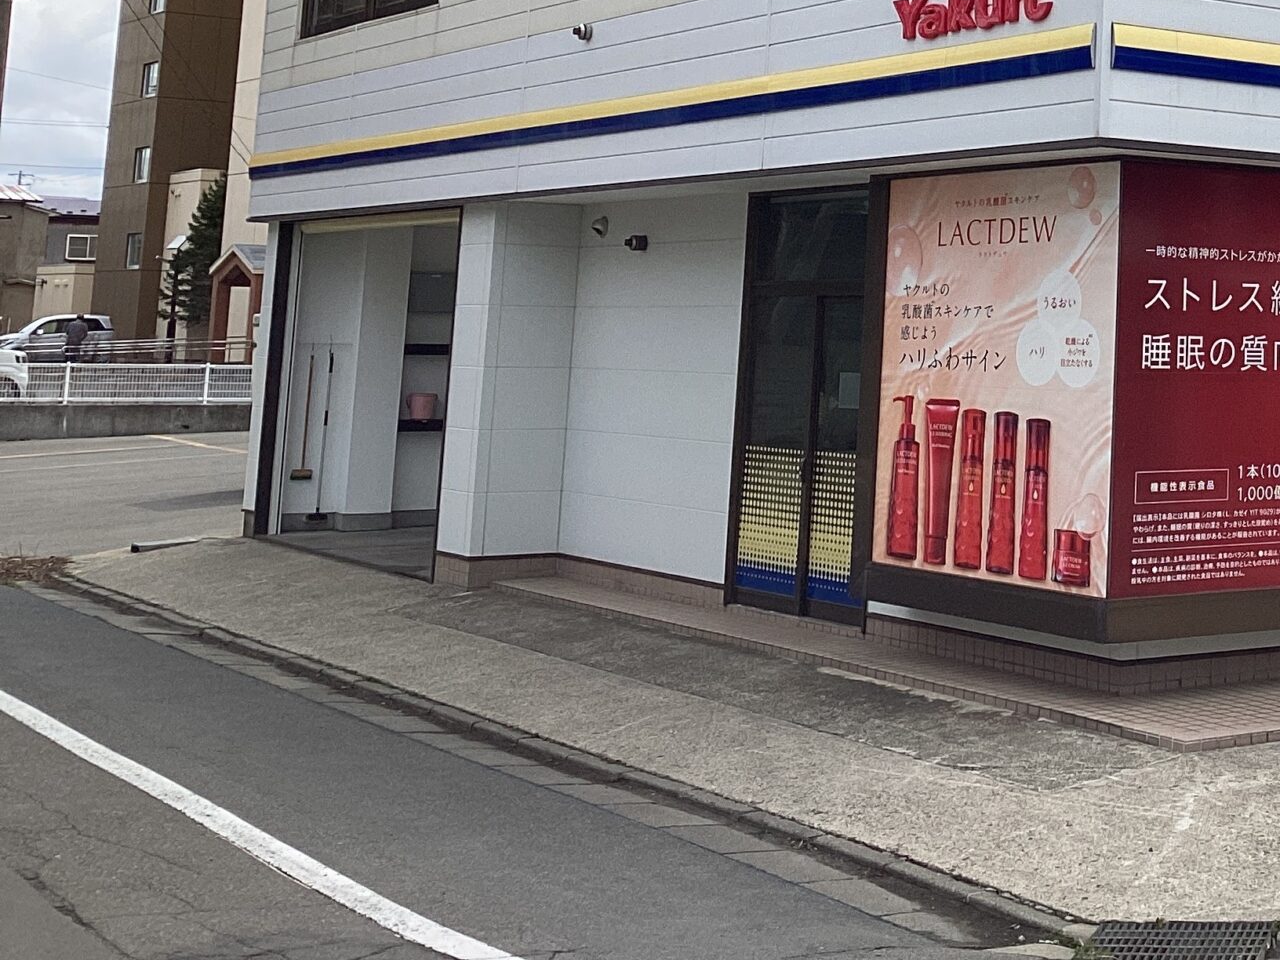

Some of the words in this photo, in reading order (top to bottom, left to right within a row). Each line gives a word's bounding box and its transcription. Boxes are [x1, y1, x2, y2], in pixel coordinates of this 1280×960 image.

[937, 215, 1057, 247] LACTDEW
[903, 283, 950, 297] ヤクルトの
[1044, 296, 1076, 310] うるおい
[901, 325, 937, 340] 感じよう
[899, 347, 1007, 372] ハリふわサイン
[1029, 346, 1045, 359] ハリ
[1150, 480, 1215, 492] 機能性表示食品
